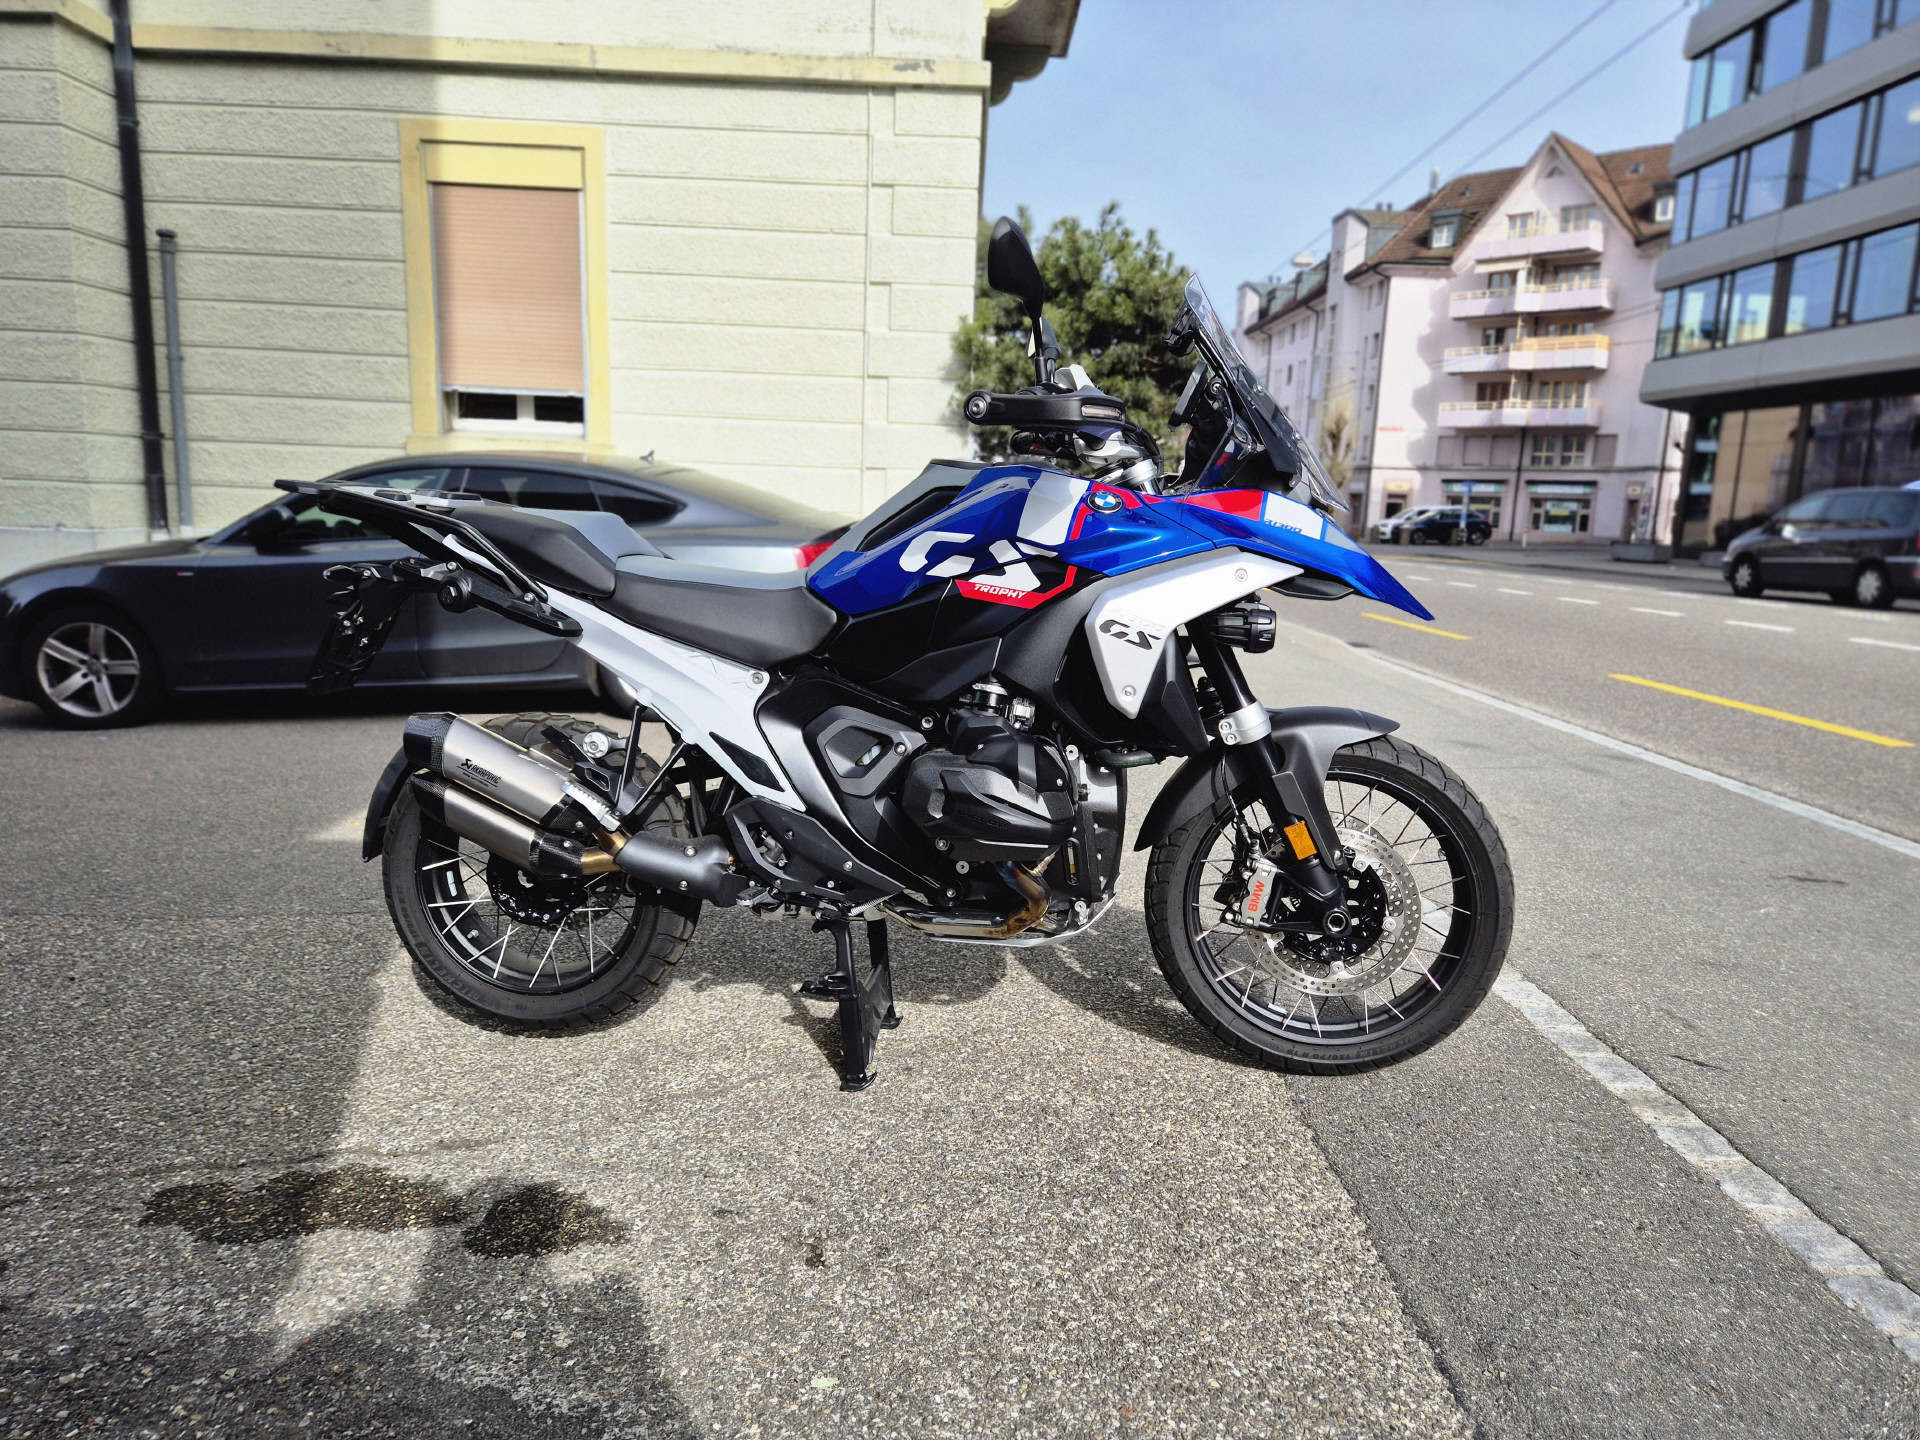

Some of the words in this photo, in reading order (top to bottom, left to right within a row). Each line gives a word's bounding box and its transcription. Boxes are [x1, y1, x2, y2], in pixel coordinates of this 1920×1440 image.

[899, 530, 1059, 592] GS
[974, 583, 1027, 599] TROPHY
[1099, 619, 1161, 650] GS
[1247, 880, 1266, 912] BMW
